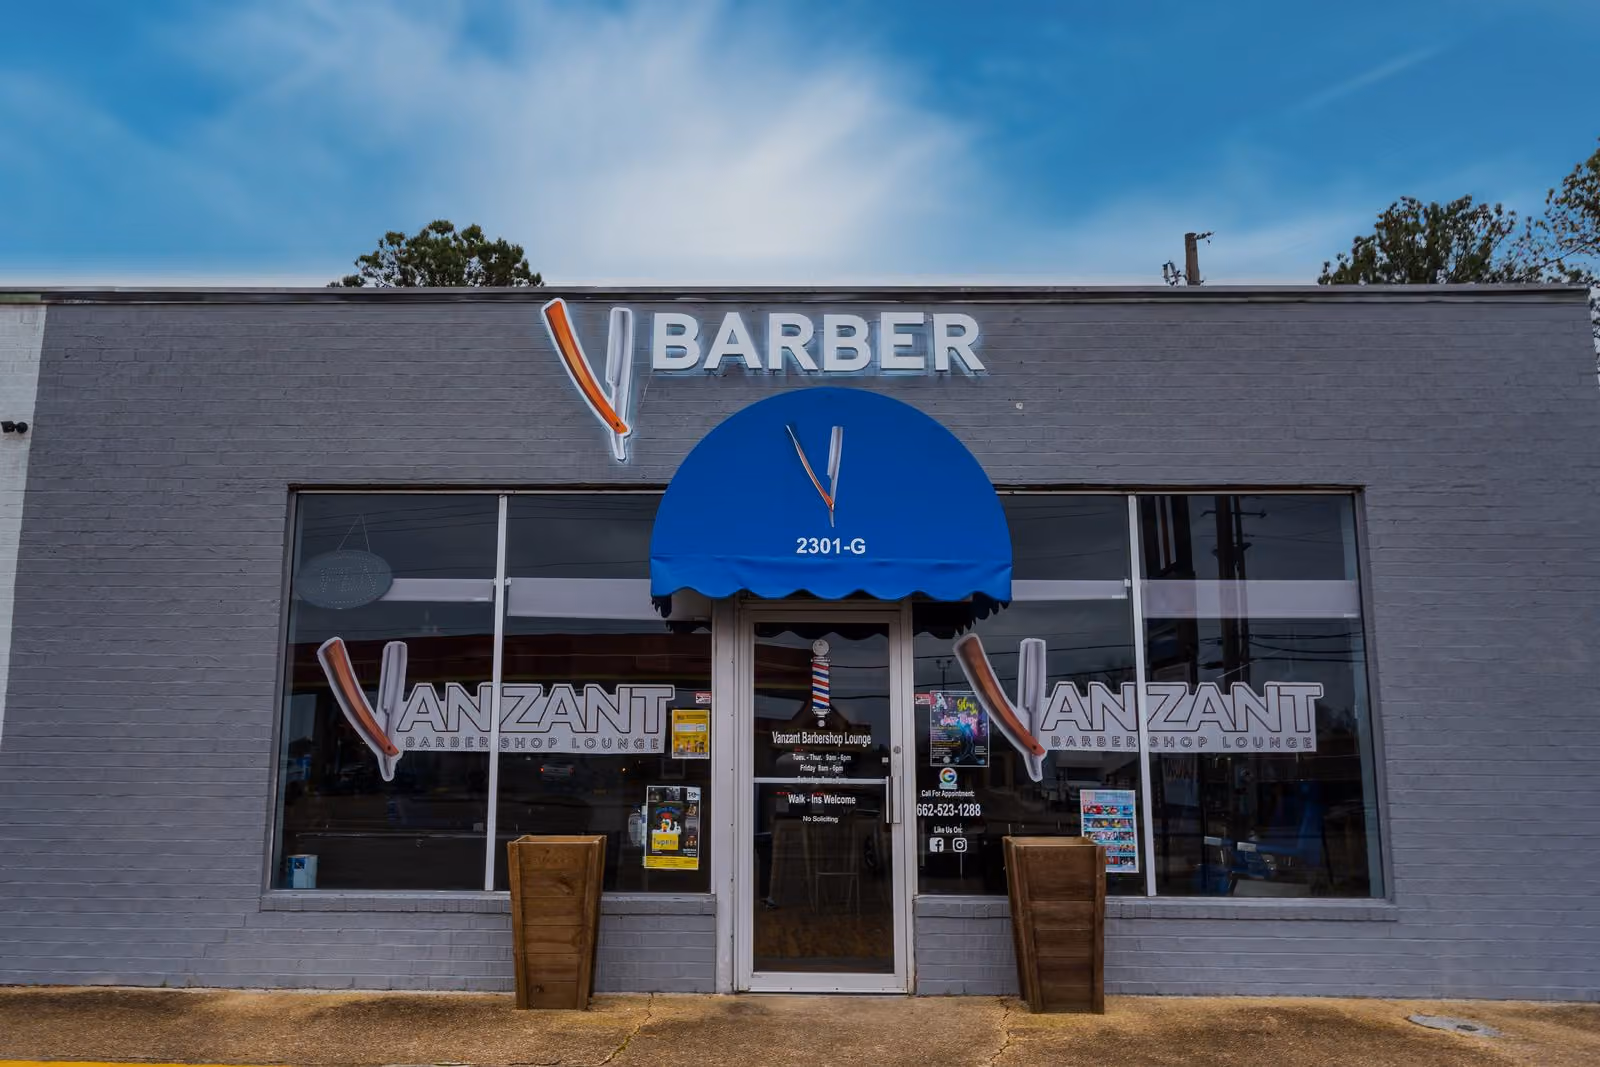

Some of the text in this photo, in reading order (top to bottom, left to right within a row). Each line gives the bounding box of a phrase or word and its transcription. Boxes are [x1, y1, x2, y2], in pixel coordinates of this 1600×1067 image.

[652, 312, 986, 372] BARBER
[796, 537, 867, 555] 2301-G
[572, 737, 659, 750] LOUNGE
[772, 731, 872, 748] Vanzant Barbershop Lounge
[1222, 736, 1313, 749] LOUNGE
[800, 764, 816, 773] Friday
[788, 794, 806, 804] Walk
[811, 794, 823, 804] Ins
[823, 794, 856, 804] Welcome
[921, 789, 932, 797] Call
[932, 789, 941, 797] For
[916, 803, 982, 817] 662-523-1288
[934, 825, 945, 834] Like
[945, 825, 953, 834] Us
